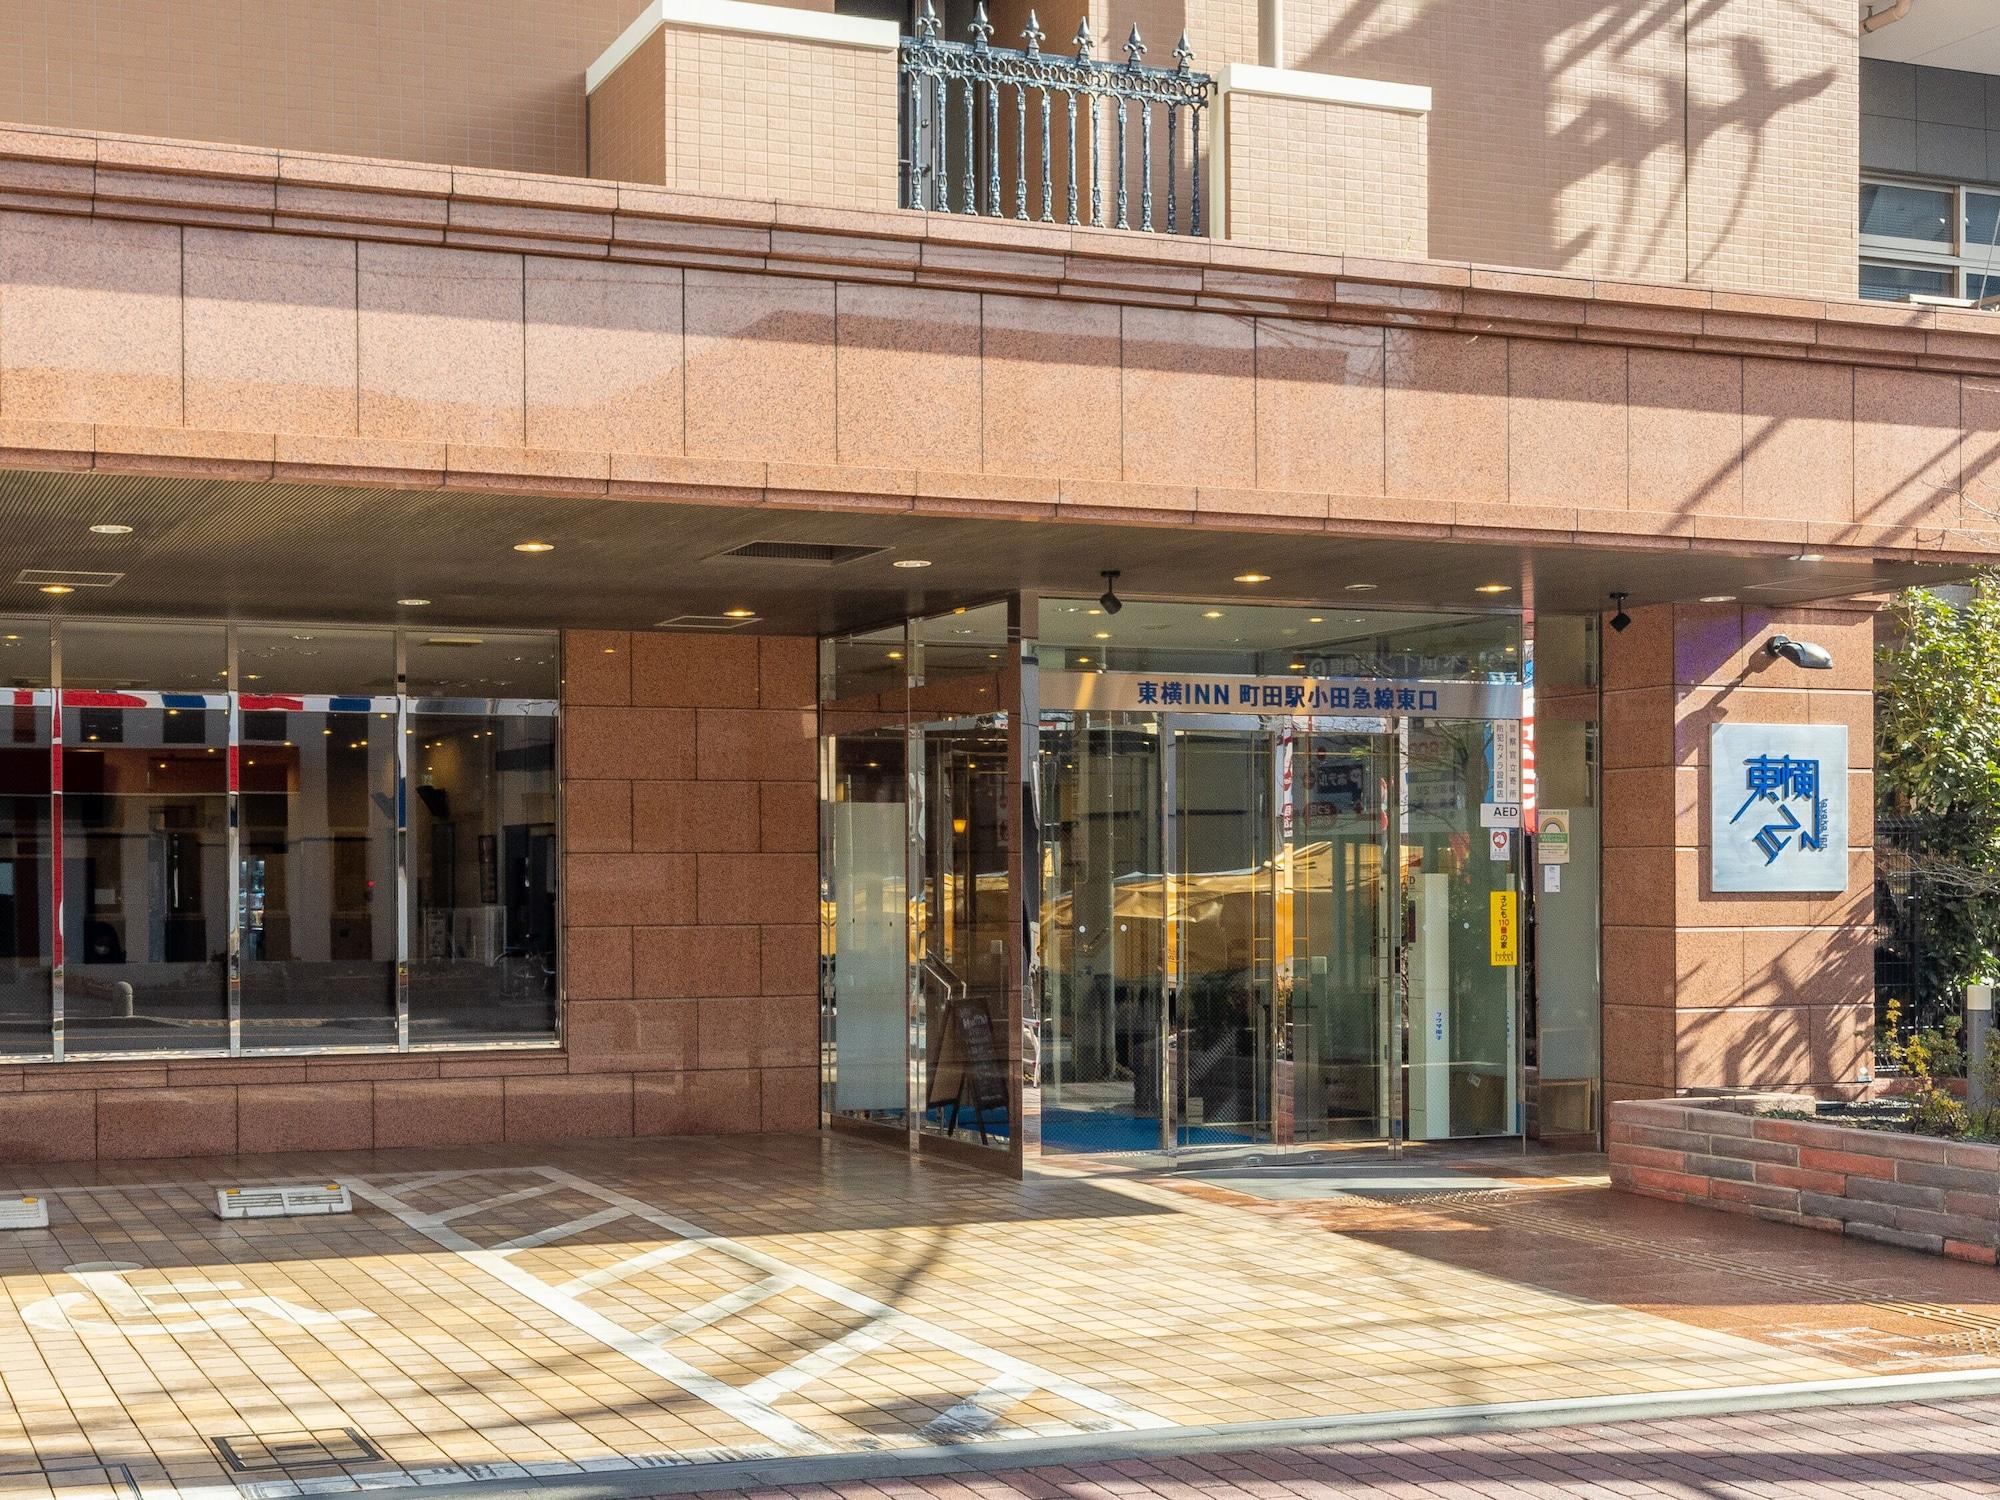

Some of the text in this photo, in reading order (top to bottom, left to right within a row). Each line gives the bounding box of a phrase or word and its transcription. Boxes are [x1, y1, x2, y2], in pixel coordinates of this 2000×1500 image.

[1137, 681, 1438, 712] 東横INN 町田駅小田急線東口
[1493, 807, 1518, 817] AED
